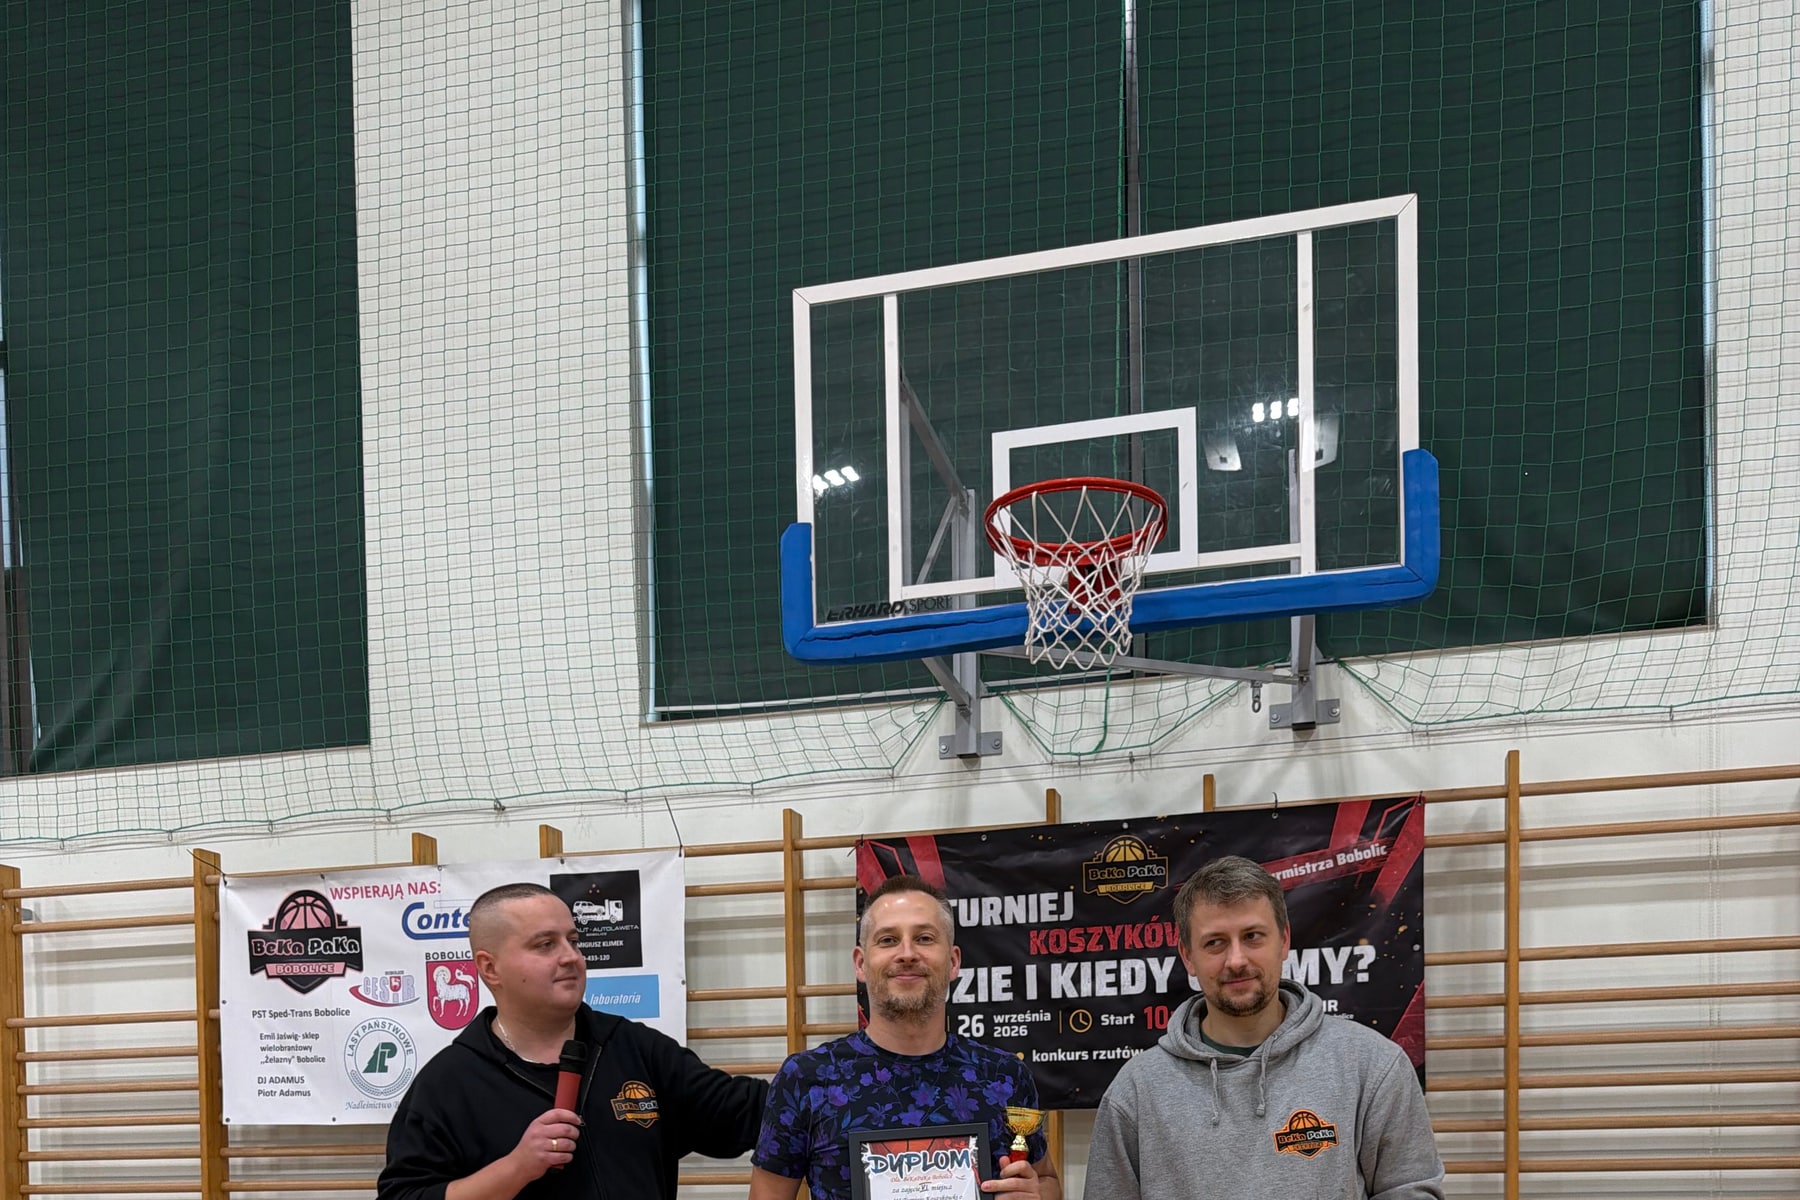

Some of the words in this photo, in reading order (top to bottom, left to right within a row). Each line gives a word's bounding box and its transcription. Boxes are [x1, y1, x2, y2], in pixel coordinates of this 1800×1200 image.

[1271, 859, 1333, 880] rmistrza
[1336, 843, 1387, 866] Bobolic
[1127, 864, 1165, 878] PaKa
[330, 884, 404, 901] WSPIERAJĄ
[408, 881, 441, 895] NAS:
[948, 891, 1074, 928] URNIEJ
[252, 939, 304, 956] BeKa
[309, 936, 360, 955] PaKa
[425, 950, 471, 961] BOBOLIC
[276, 964, 335, 974] BOBOLICE
[945, 966, 1014, 1004] ZIE
[1025, 964, 1037, 1000] I
[1050, 956, 1176, 999] KIEDY
[590, 992, 641, 1005] laboratoria
[252, 1010, 266, 1019] PST
[269, 1009, 312, 1019] Sped-Trans
[314, 1008, 350, 1017] Bobolice
[958, 1014, 985, 1038] 26
[993, 1009, 1051, 1023] września
[1101, 1013, 1135, 1026] Start
[1143, 1005, 1169, 1029] 10
[302, 1032, 319, 1040] sklep
[347, 1030, 361, 1057] LASY
[361, 1019, 414, 1056] PAŃSTWOWE
[993, 1025, 1028, 1037] 2026
[260, 1044, 312, 1053] wielobranżowy
[1032, 1048, 1089, 1062] konkurs
[269, 1076, 305, 1084] ADAMUS
[279, 1089, 311, 1097] Adamus
[867, 1149, 971, 1180] DYPLOM
